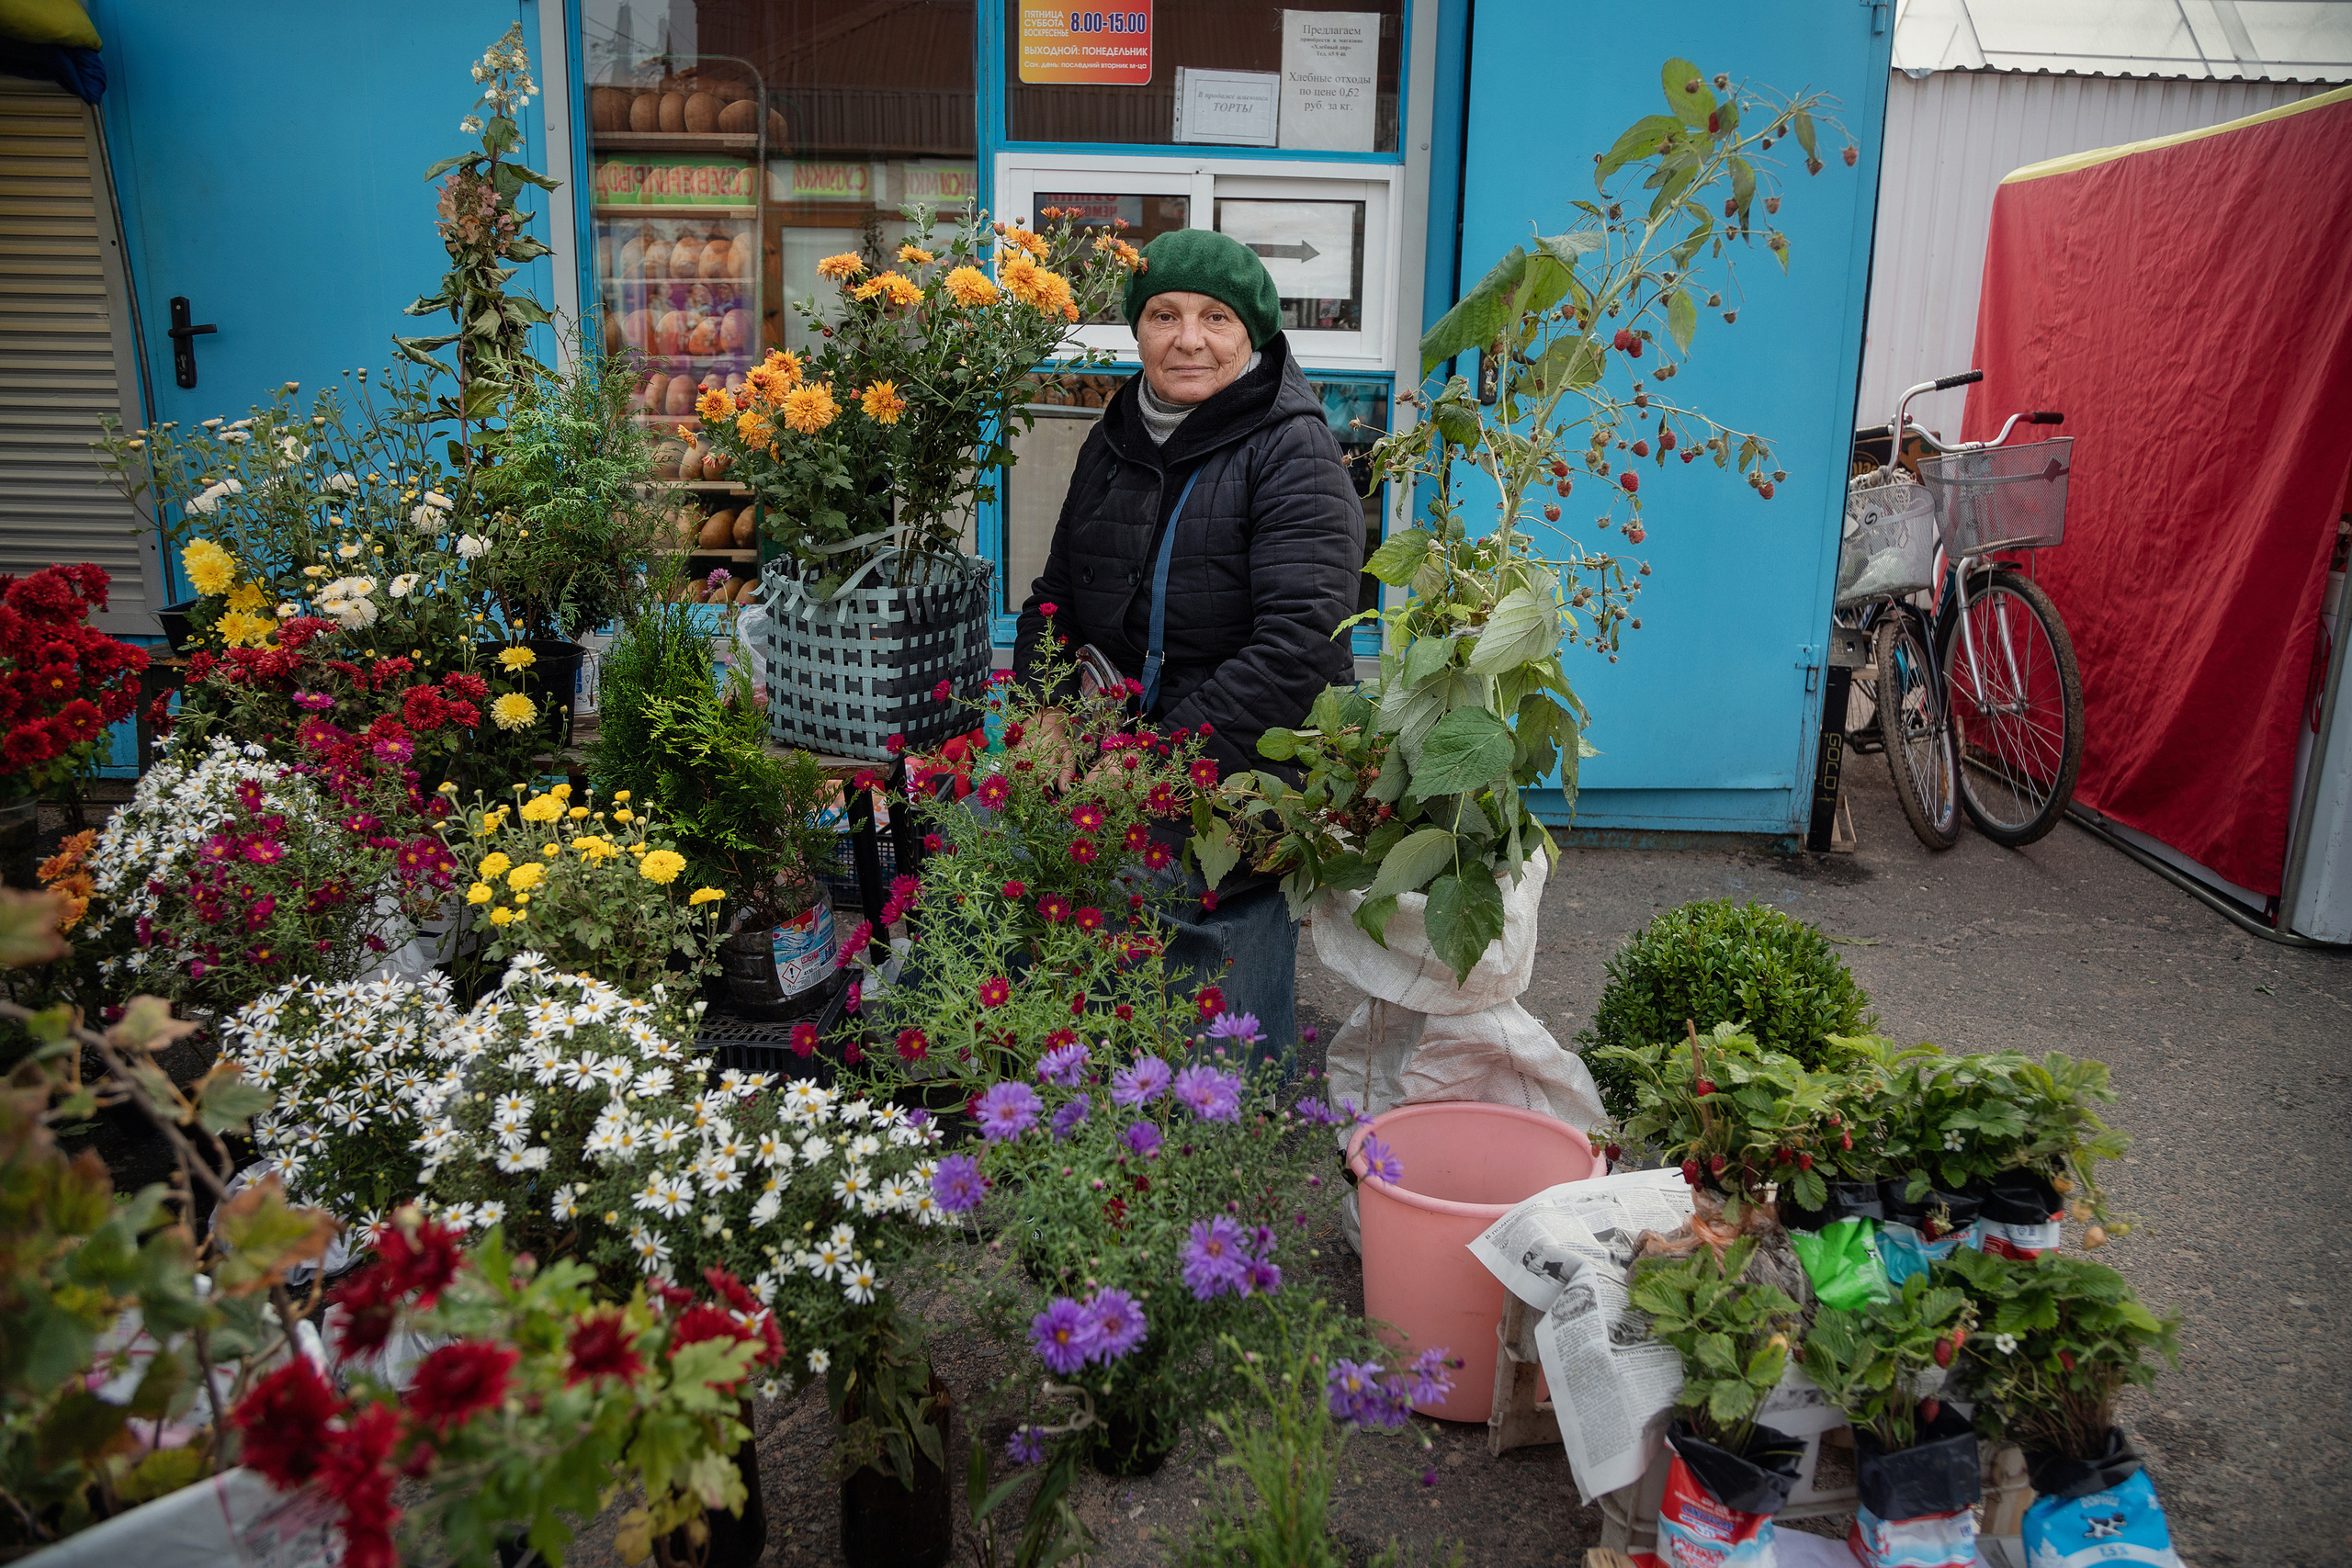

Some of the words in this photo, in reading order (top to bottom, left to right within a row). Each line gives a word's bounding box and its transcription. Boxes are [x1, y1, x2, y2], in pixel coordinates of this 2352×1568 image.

[1024, 10, 1064, 19] ПЯТНИЦА
[1024, 19, 1064, 28] СУББОТА
[1070, 11, 1147, 33] 8.00-15.00
[1023, 28, 1069, 38] ВОСКРЕСЕНЬЕ
[1302, 24, 1362, 36] Предлагаем
[1024, 45, 1080, 55] ВЫХОДНОЙ:
[1081, 47, 1148, 57] ПОНЕДЕЛЬНИК
[1060, 62, 1100, 70] последний
[1288, 72, 1332, 83] Хлебные
[1335, 75, 1371, 85] отходы
[1204, 92, 1236, 100] продаже
[1314, 89, 1338, 97] цене
[1213, 102, 1254, 114] ТОРТЫ
[1304, 101, 1325, 112] руб.
[1340, 103, 1353, 111] кг.
[1824, 732, 1842, 791] GOLD
